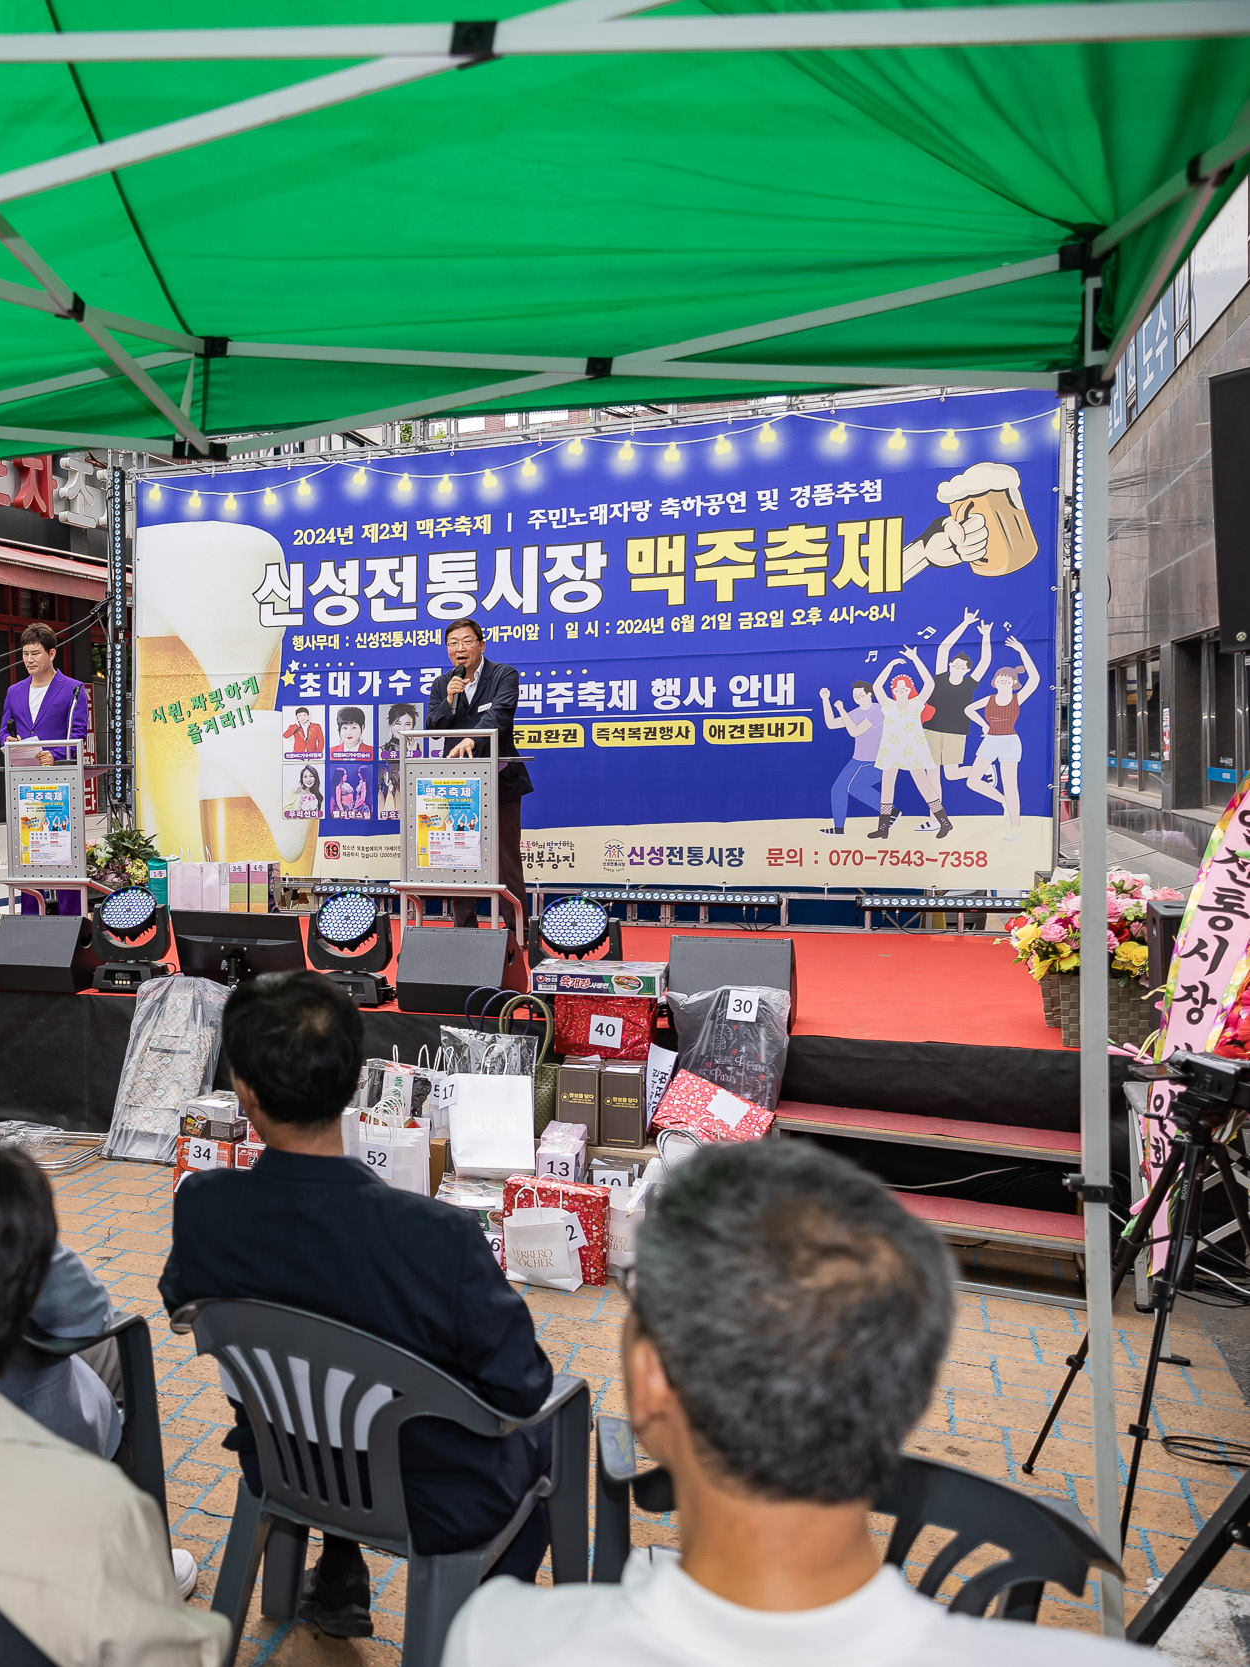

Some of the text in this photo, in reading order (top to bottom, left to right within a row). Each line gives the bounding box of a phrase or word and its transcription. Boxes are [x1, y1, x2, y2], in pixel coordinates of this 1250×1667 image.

[293, 479, 883, 545] 2024년 제2회 맥주축제 주민노래자랑 축하공연 및 경품추첨
[252, 515, 905, 628] 신성전통시장 맥주축제
[292, 633, 340, 651] 행사무대
[355, 628, 442, 649] 신성전통시장내
[616, 617, 665, 635] 2024년
[671, 614, 695, 632] 6월
[701, 613, 732, 630] 21일
[738, 609, 784, 629] 금요일
[790, 607, 822, 626] 오후
[829, 603, 896, 623] 4시~8시
[519, 673, 795, 714] 맥주축제 행사 안내
[187, 705, 253, 744] 즐겨라!!
[708, 722, 805, 740] 애견뽐내기
[596, 726, 690, 742] 즉석복권행사
[26, 792, 63, 801] 맥주축제
[425, 787, 471, 798] 맥주축제
[326, 844, 339, 857] 19
[627, 846, 744, 867] 신성전통시장
[766, 848, 804, 867] 문의
[829, 849, 988, 868] 070-7543-7358
[560, 975, 590, 989] 육개장
[733, 999, 753, 1013] 30
[594, 1023, 616, 1037] 40
[443, 1084, 454, 1100] 17
[193, 1145, 211, 1161] 34
[366, 1151, 387, 1167] 52
[546, 1161, 570, 1176] 13
[1180, 1179, 1189, 1200] SONY
[512, 1249, 552, 1258] FERRERO
[514, 1257, 554, 1267] ROCHER
